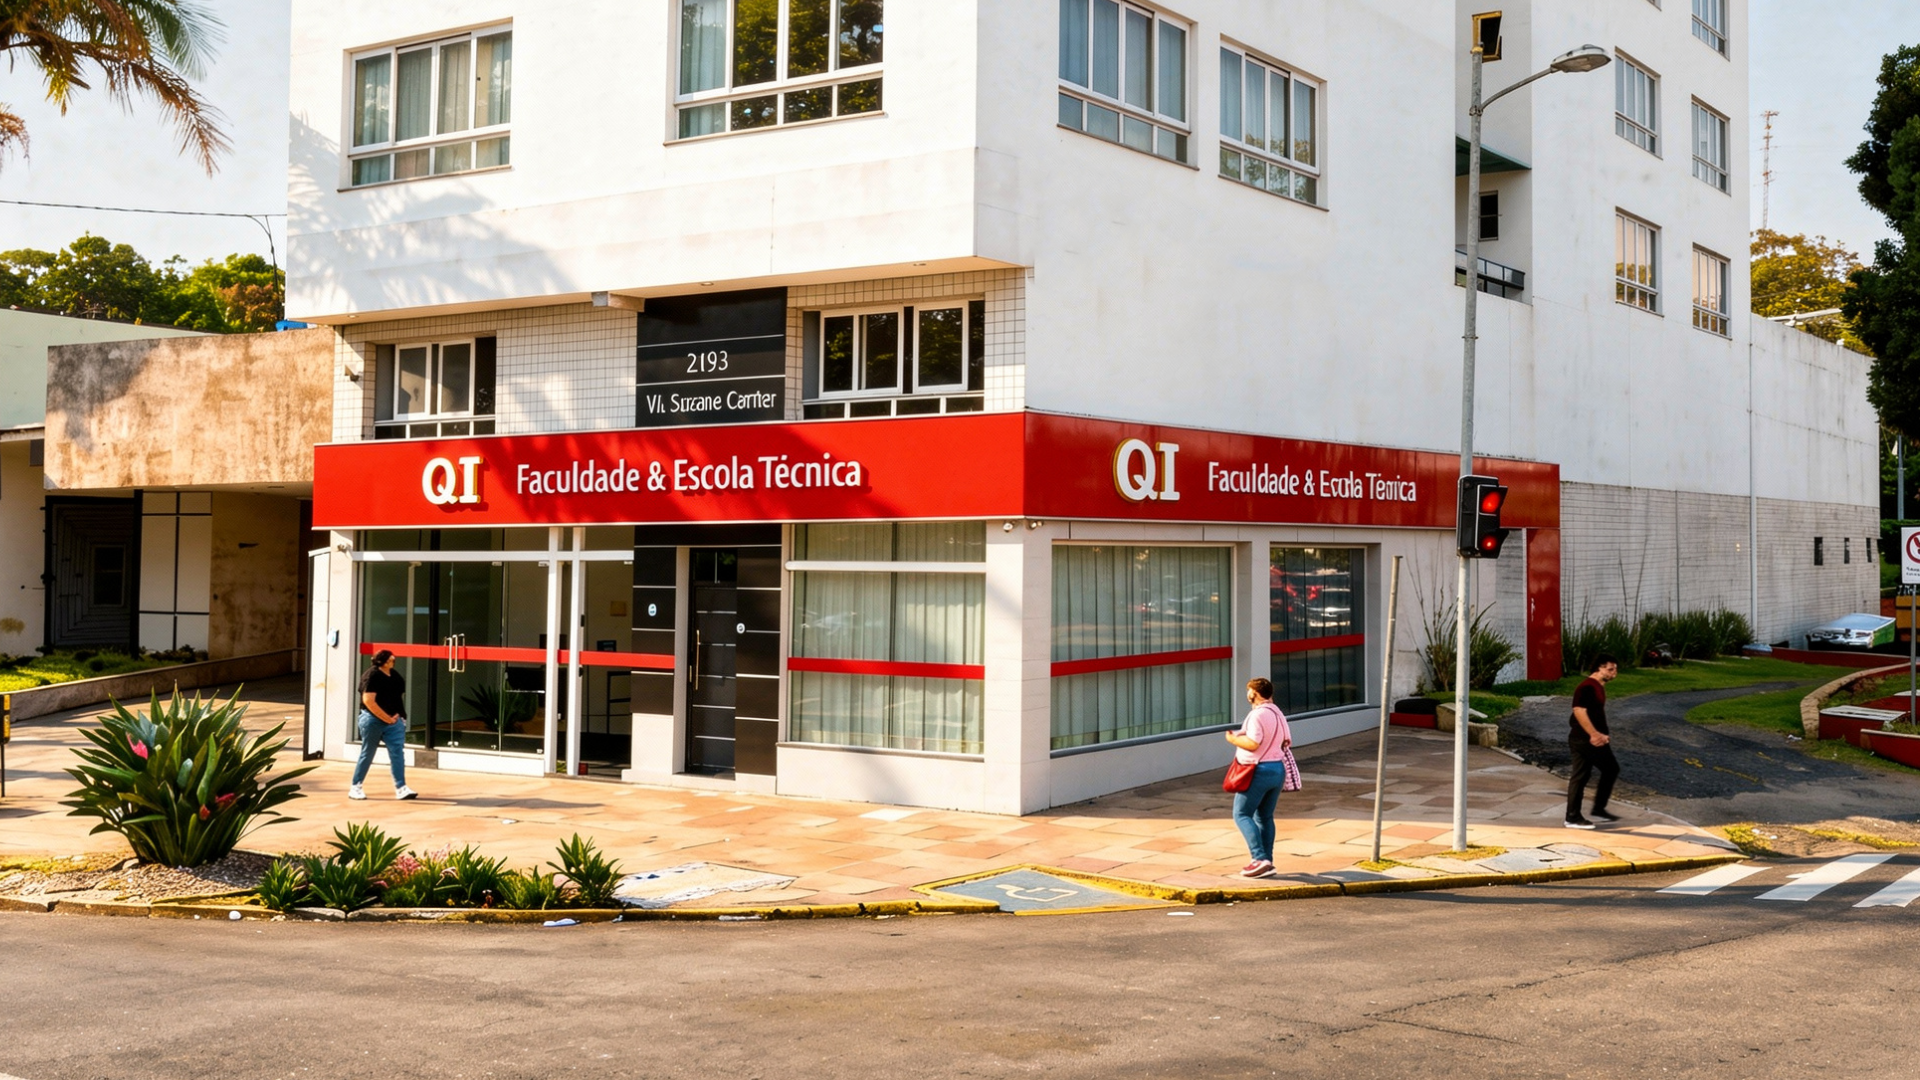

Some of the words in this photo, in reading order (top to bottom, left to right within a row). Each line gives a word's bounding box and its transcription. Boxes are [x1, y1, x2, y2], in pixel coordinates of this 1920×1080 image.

[687, 350, 729, 374] 2193
[421, 455, 482, 505] QI
[517, 458, 640, 495] Faculdade
[646, 460, 667, 492] &
[673, 454, 755, 491] Escola
[757, 451, 862, 489] Técnica
[1113, 438, 1181, 502] QI
[1208, 461, 1300, 496] Faculdade
[1303, 468, 1316, 496] &
